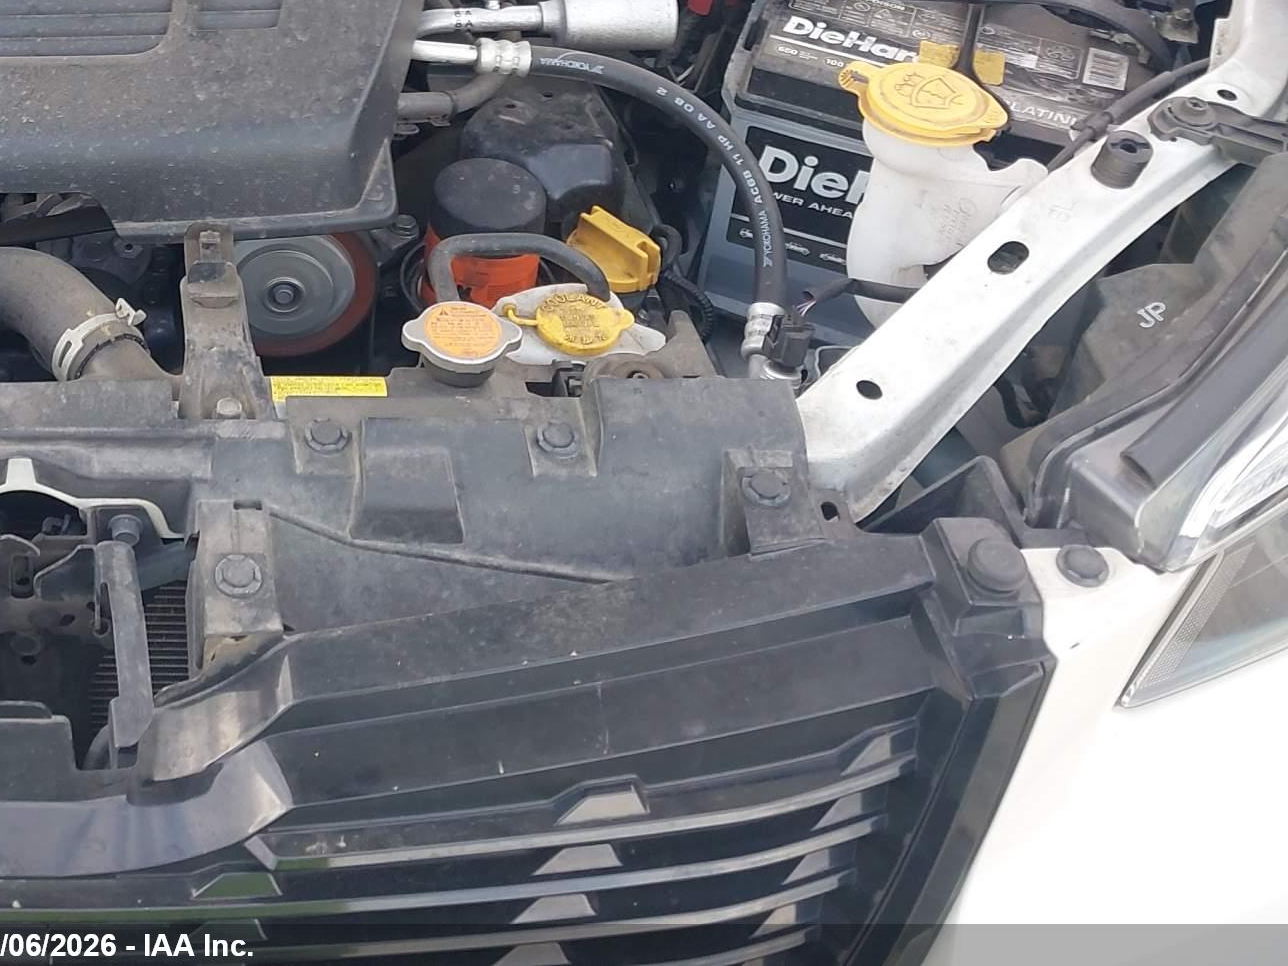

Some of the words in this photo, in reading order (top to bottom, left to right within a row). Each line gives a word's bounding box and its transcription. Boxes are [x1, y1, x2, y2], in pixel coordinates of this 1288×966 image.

[783, 15, 920, 63] DieHar
[1007, 100, 1078, 126] LATIN
[718, 134, 733, 151] HP
[807, 202, 854, 219] AHEA
[759, 209, 773, 256] YOKOHAMA
[1136, 301, 1167, 328] JP
